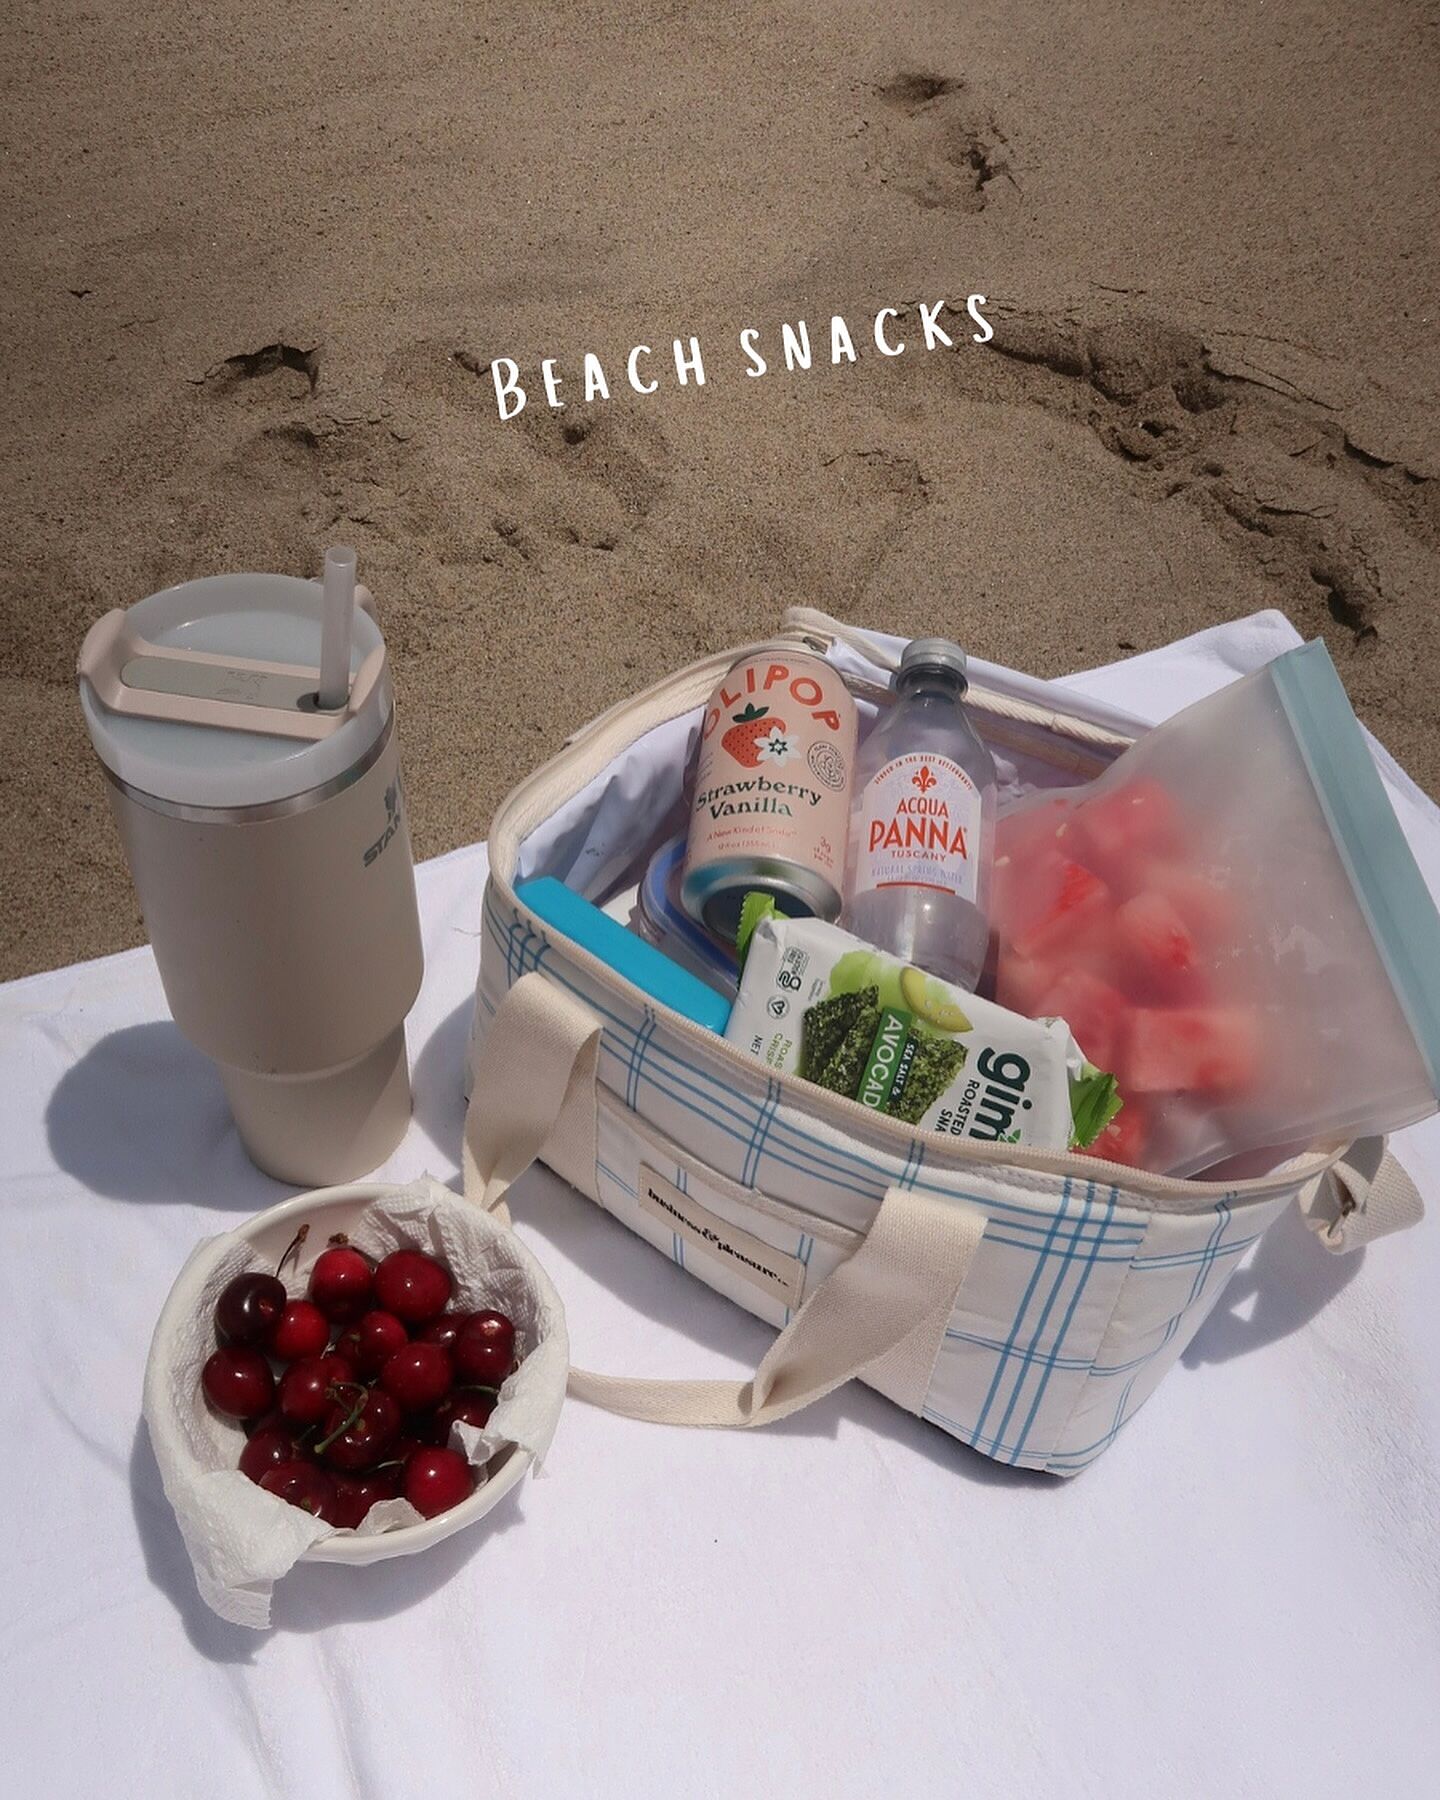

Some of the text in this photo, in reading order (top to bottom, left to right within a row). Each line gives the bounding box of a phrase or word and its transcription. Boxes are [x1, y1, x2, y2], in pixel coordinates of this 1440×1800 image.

[703, 664, 841, 741] OLIPOP
[696, 776, 822, 812] Strawberry
[709, 797, 793, 820] Vanilla
[896, 797, 949, 819] ACQUA
[869, 817, 967, 860] PANNA
[891, 850, 946, 862] TUSCANY
[750, 1034, 763, 1055] NET
[902, 1042, 915, 1060] SEA
[862, 1014, 903, 1108] AVOCAD
[896, 1063, 909, 1085] SALT
[950, 1079, 980, 1136] ROASTED
